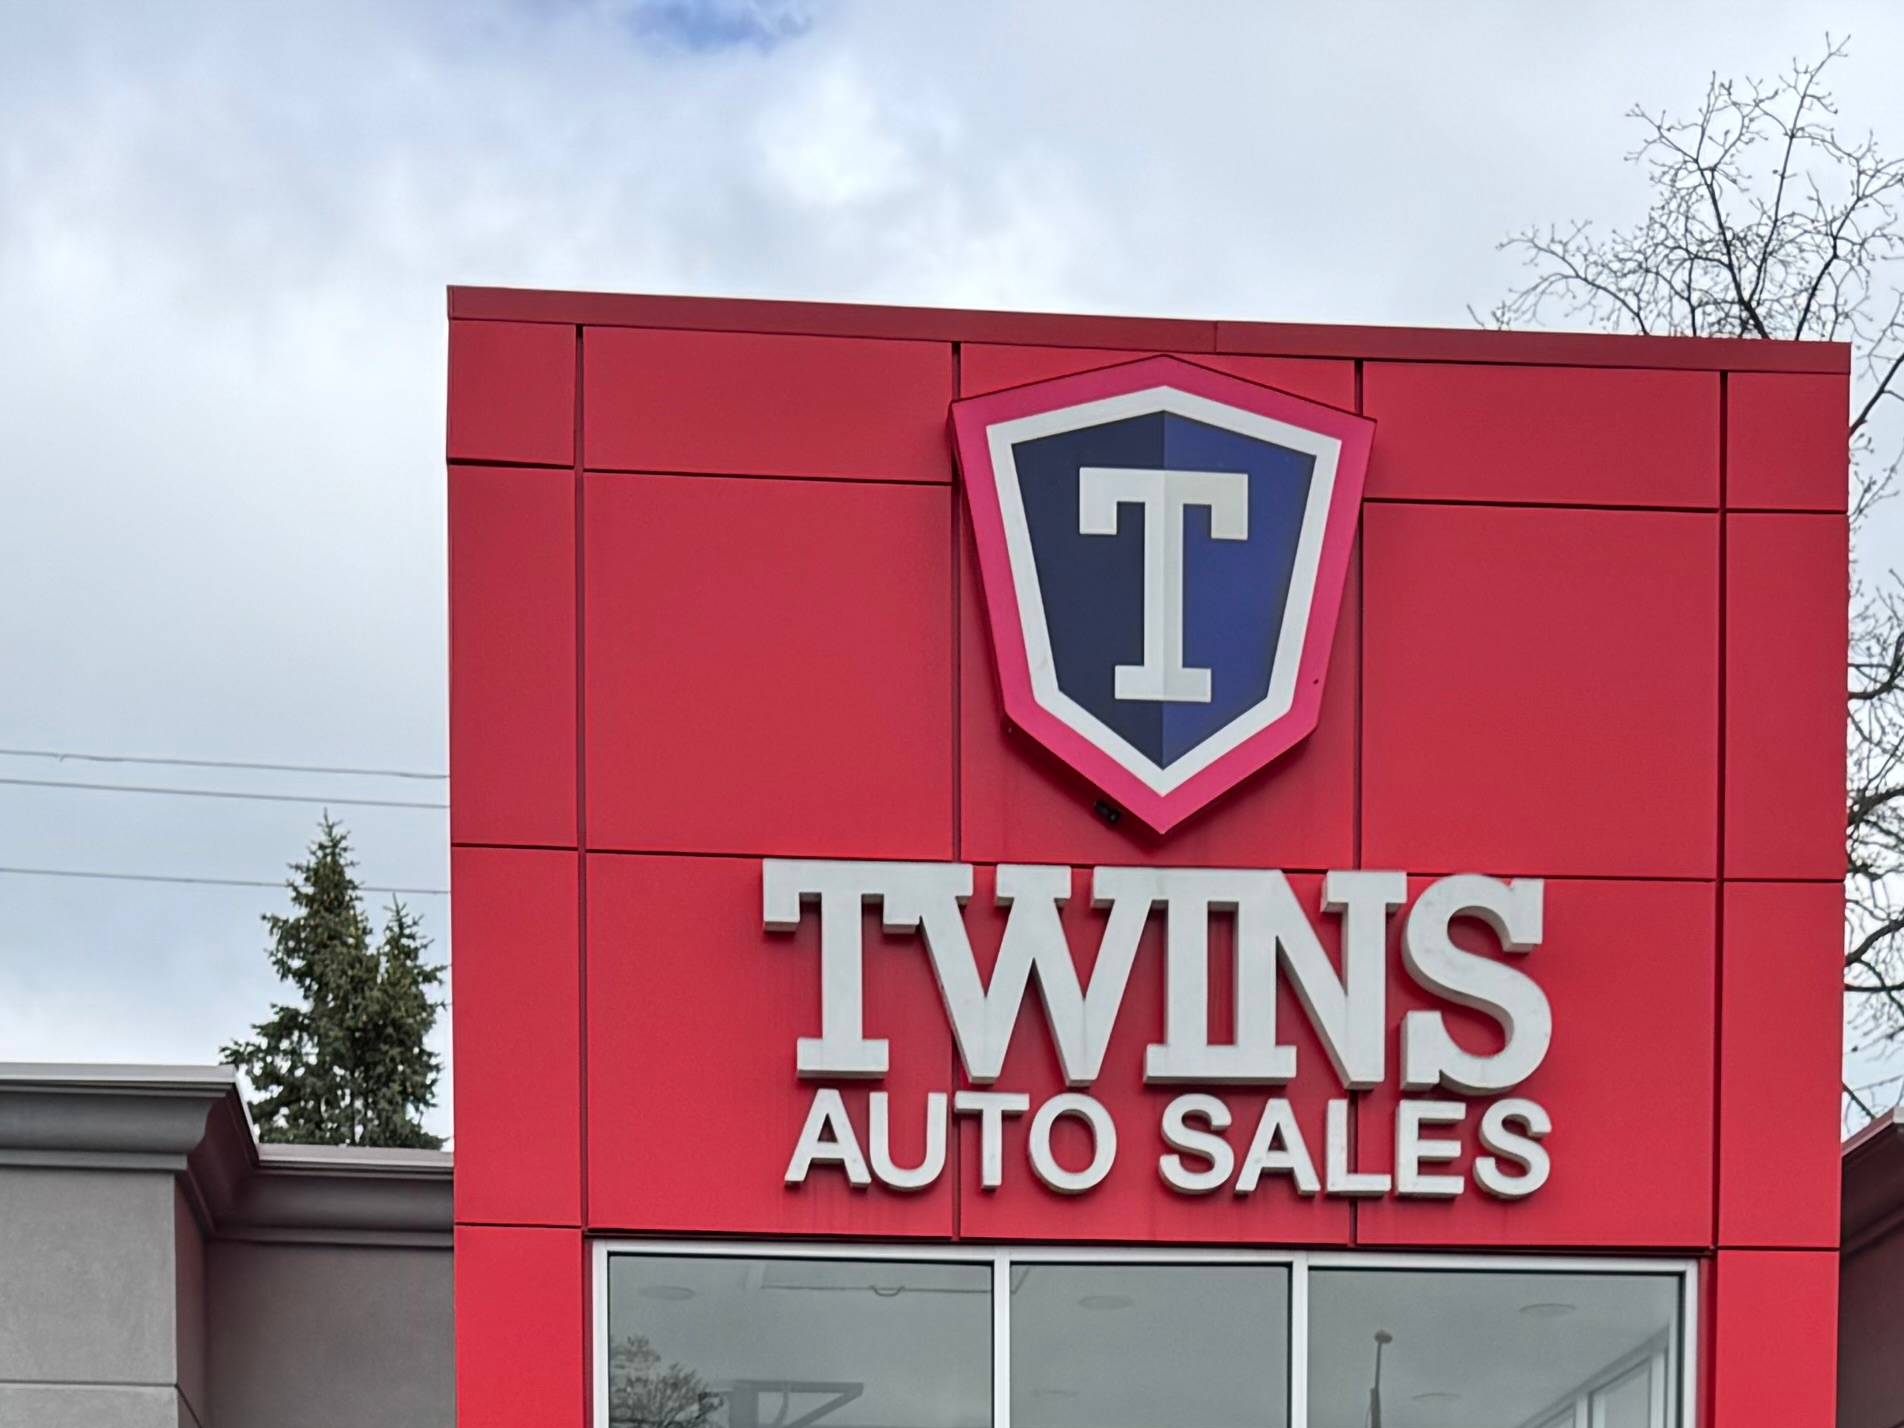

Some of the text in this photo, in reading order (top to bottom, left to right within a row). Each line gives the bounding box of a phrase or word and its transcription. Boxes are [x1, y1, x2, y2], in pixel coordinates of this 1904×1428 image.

[1078, 467, 1250, 703] T
[762, 859, 1552, 1094] TWINS
[784, 1093, 1553, 1201] AUTO SALES
